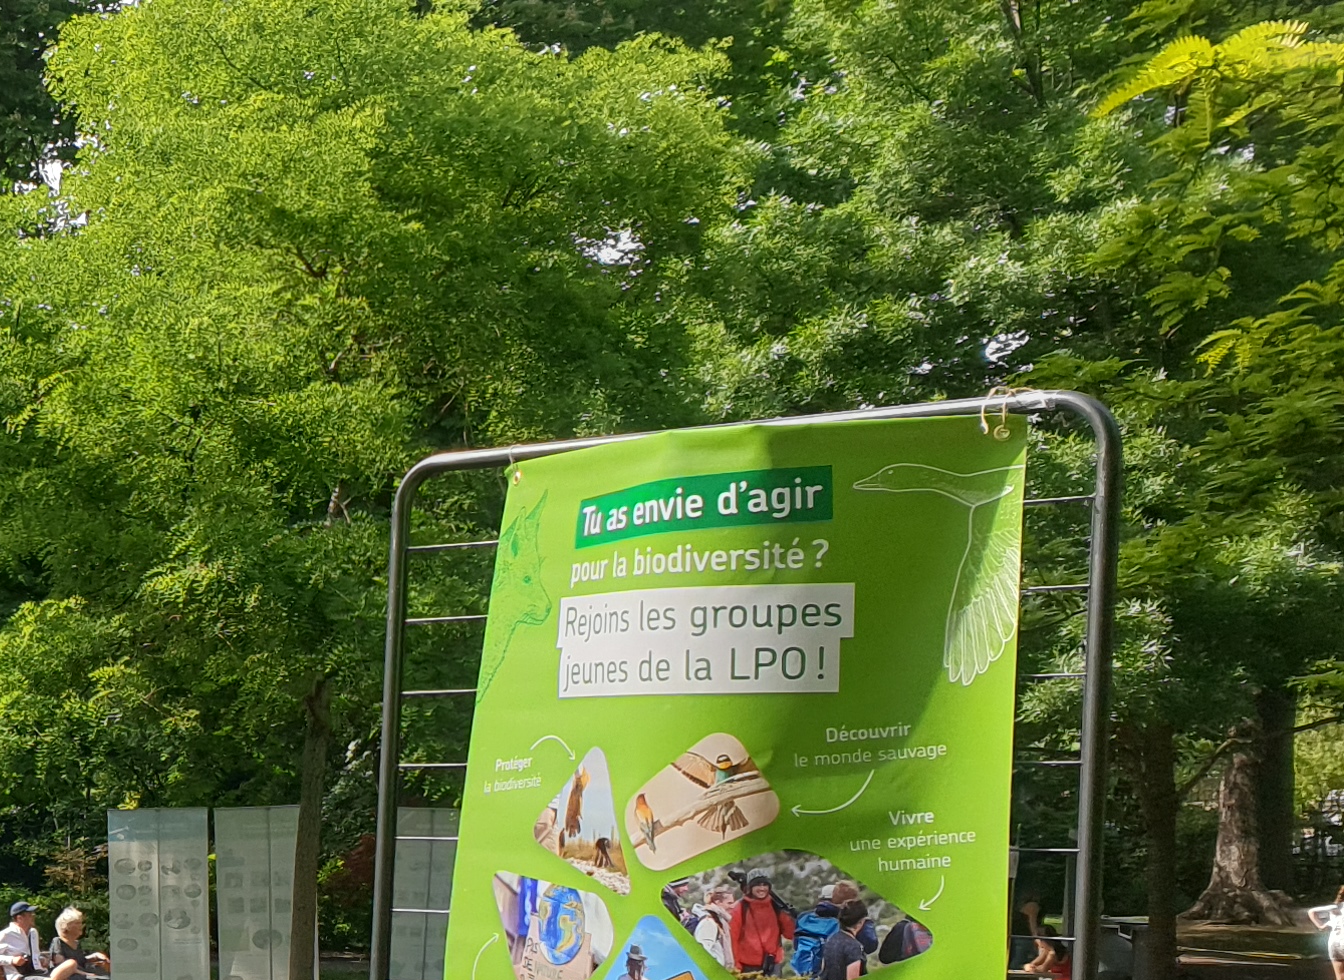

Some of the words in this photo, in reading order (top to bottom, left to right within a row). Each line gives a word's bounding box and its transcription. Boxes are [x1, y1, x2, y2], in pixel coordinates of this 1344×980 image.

[582, 504, 603, 537] Tu
[605, 505, 629, 531] as
[633, 487, 703, 527] envie
[717, 479, 823, 518] d'agir
[570, 556, 607, 588] pour
[611, 548, 626, 578] la
[632, 537, 804, 574] biodiversité
[813, 539, 829, 567] ?
[565, 605, 630, 640] Rejoins
[638, 602, 676, 630] les
[690, 597, 842, 634] groupes
[563, 656, 628, 690] jeunes
[637, 652, 670, 680] de
[685, 649, 712, 680] la
[730, 645, 806, 680] LPO
[825, 721, 911, 745] Découvrir
[495, 755, 533, 773] Protéger
[793, 750, 810, 768] le
[814, 747, 873, 765] monde
[877, 742, 947, 764] sauvage
[484, 777, 492, 792] la
[494, 774, 541, 791] biodiversité
[888, 809, 935, 826] Vivre
[849, 835, 881, 850] une
[886, 827, 976, 854] expérience
[877, 853, 951, 872] humaine
